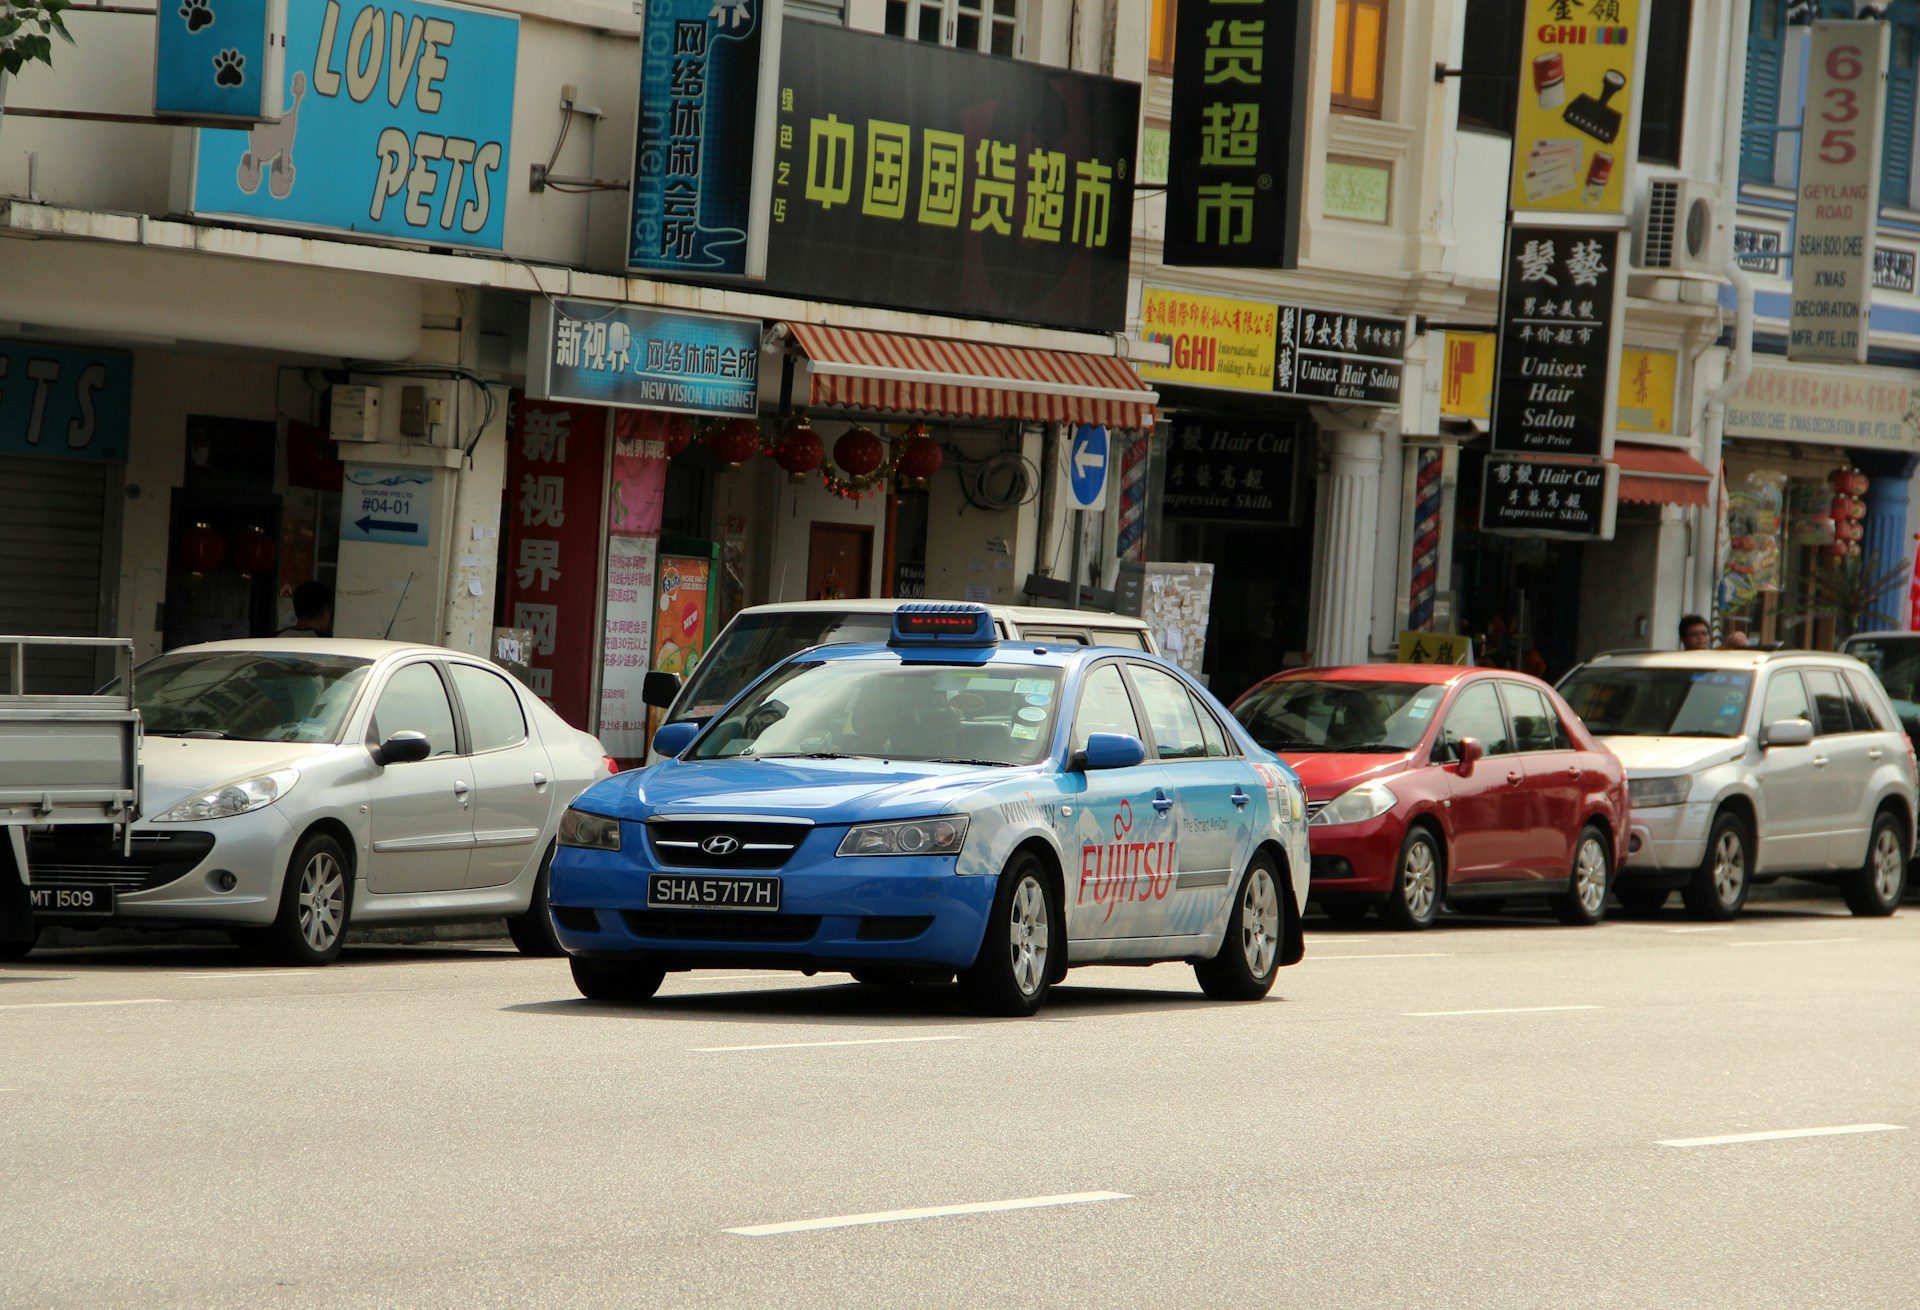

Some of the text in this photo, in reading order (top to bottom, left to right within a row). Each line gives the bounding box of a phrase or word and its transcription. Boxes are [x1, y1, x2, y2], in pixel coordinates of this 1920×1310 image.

[1538, 24, 1586, 45] GHI
[313, 0, 455, 114] LOVE
[1818, 45, 1863, 164] 635
[1197, 0, 1265, 245] 货超市
[660, 20, 707, 259] 网络休闲会所
[369, 126, 502, 233] PETS
[805, 113, 1112, 248] 中国国货超市
[1804, 184, 1868, 199] GEYLANG
[1815, 205, 1853, 220] ROAD
[1800, 235, 1864, 257] SEAH SOO CHEE
[1815, 271, 1846, 287] X'MAS
[1795, 301, 1860, 318] DECORATION
[556, 317, 631, 374] 新视界
[1175, 333, 1217, 372] GHI
[1218, 340, 1259, 358] International
[645, 339, 757, 381] 网络休闲会所
[1217, 359, 1244, 377] Holdings
[1521, 356, 1586, 379] Unisex
[1300, 359, 1400, 389] Unisex Hair Salon
[0, 353, 107, 450] TS
[640, 381, 756, 409] NEW VISION INTERNET
[1334, 384, 1365, 398] Fair Price
[1528, 383, 1574, 403] Hair
[1522, 408, 1576, 429] Salon
[1210, 430, 1255, 451] Hair
[1257, 432, 1292, 453] Cut
[1524, 434, 1572, 446] Fair Price
[1538, 468, 1572, 485] Hair
[1575, 470, 1601, 486] Cut
[361, 498, 410, 515] #04-01
[1233, 493, 1274, 510] Skills
[1500, 506, 1589, 521] Impressive Skills
[683, 610, 698, 630] NEW
[1183, 816, 1229, 833] The Smart Air-Con
[656, 879, 771, 903] SHA5717H
[1077, 841, 1174, 924] FUJITSU
[56, 890, 93, 907] 1509
